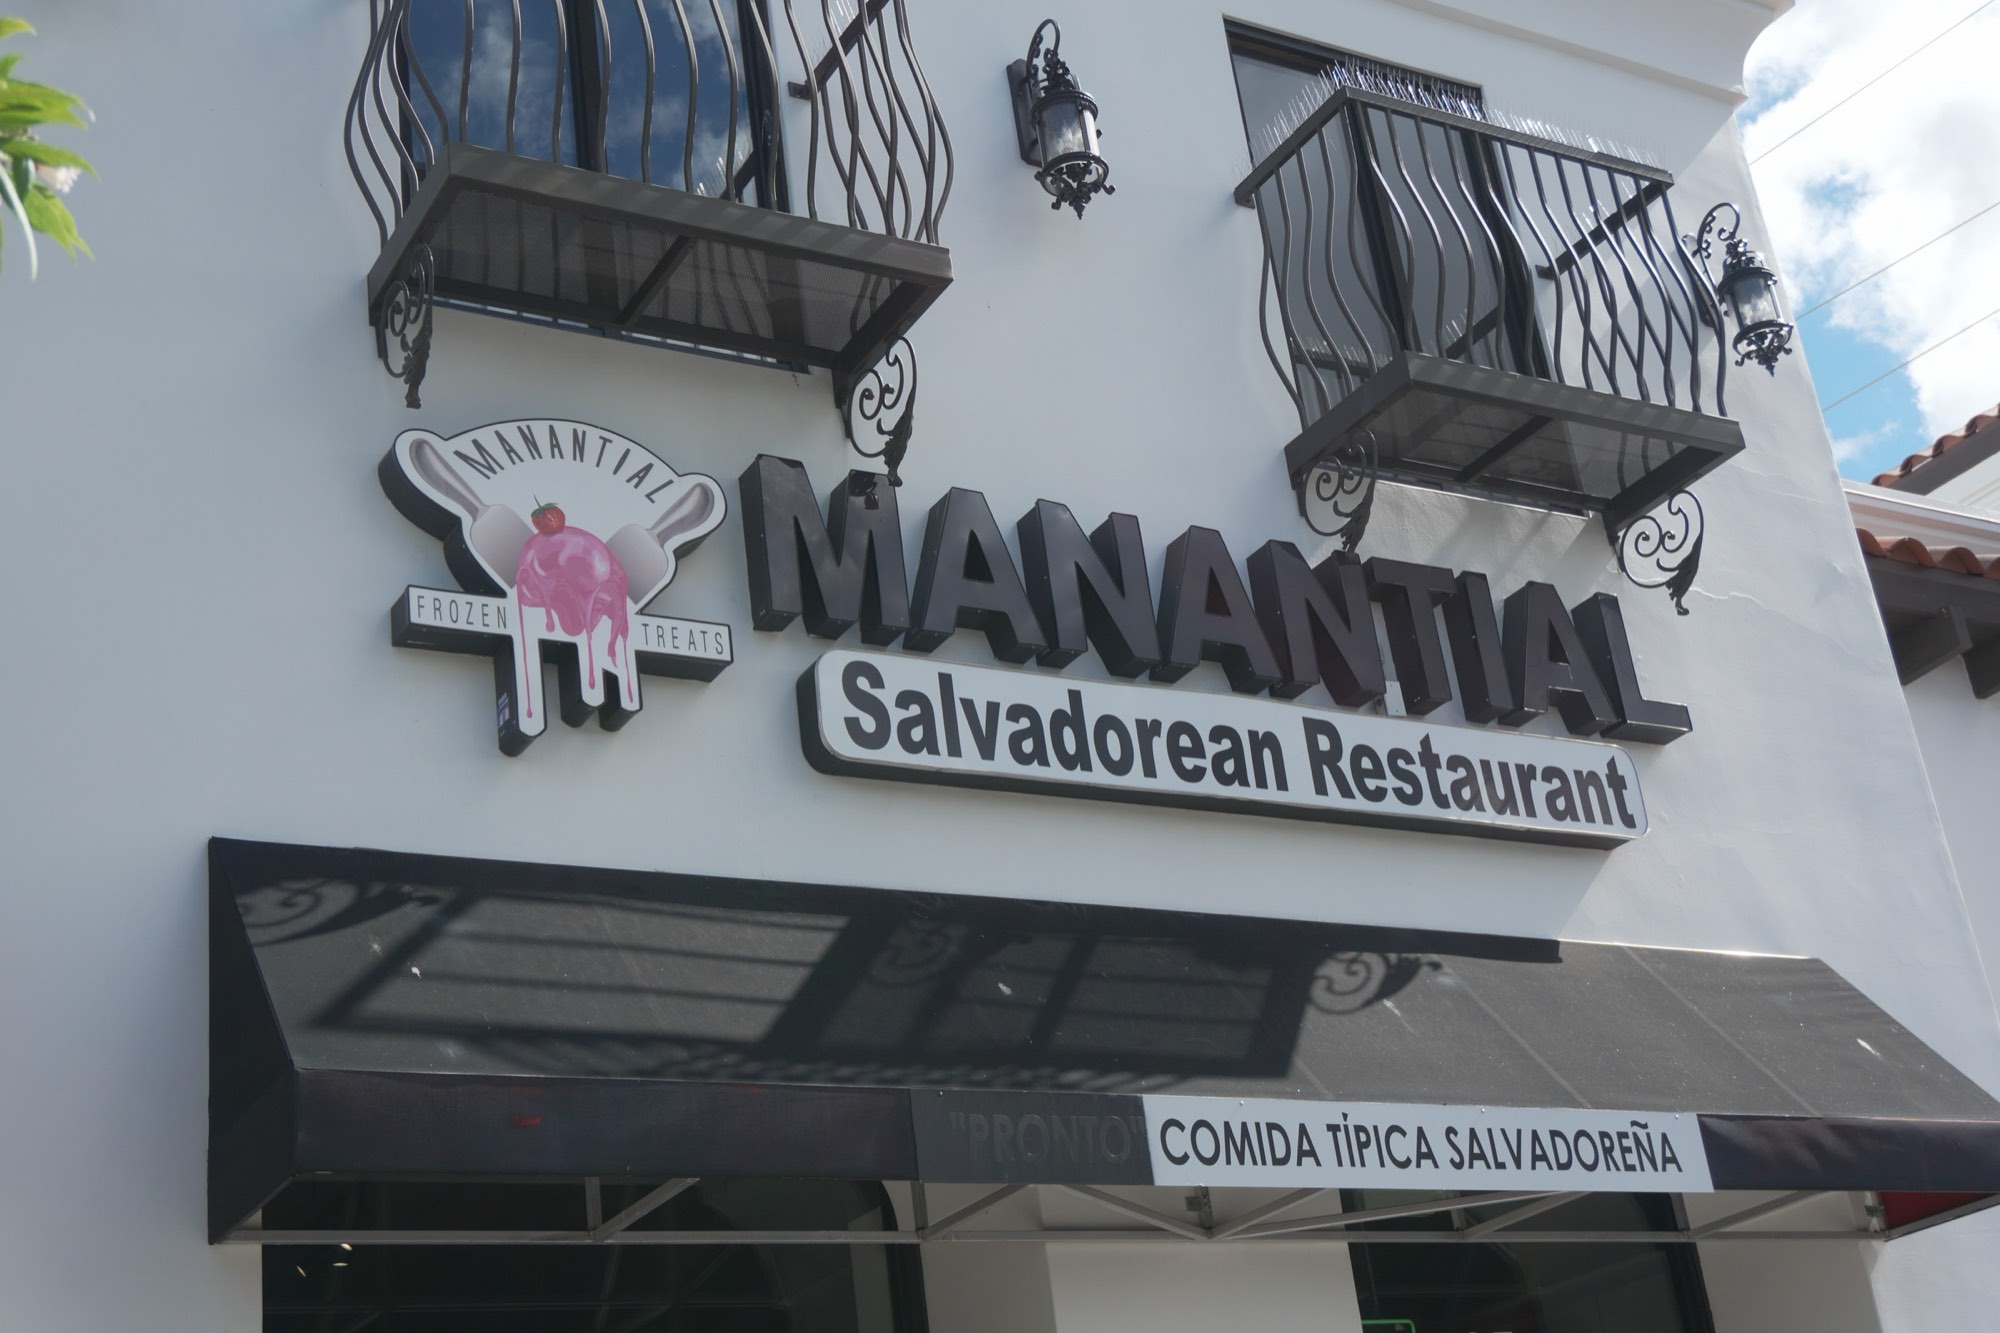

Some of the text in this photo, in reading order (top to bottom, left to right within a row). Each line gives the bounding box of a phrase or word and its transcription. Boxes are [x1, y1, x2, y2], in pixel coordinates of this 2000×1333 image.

[453, 424, 674, 504] MANANTIAL
[416, 595, 725, 656] FROZEN TREATS
[740, 452, 1692, 746] MANANTIAL
[841, 659, 1636, 831] Salvadorean Restaurant
[1160, 1111, 1684, 1173] COMIDA TÍPICA SALVADOREÑA
